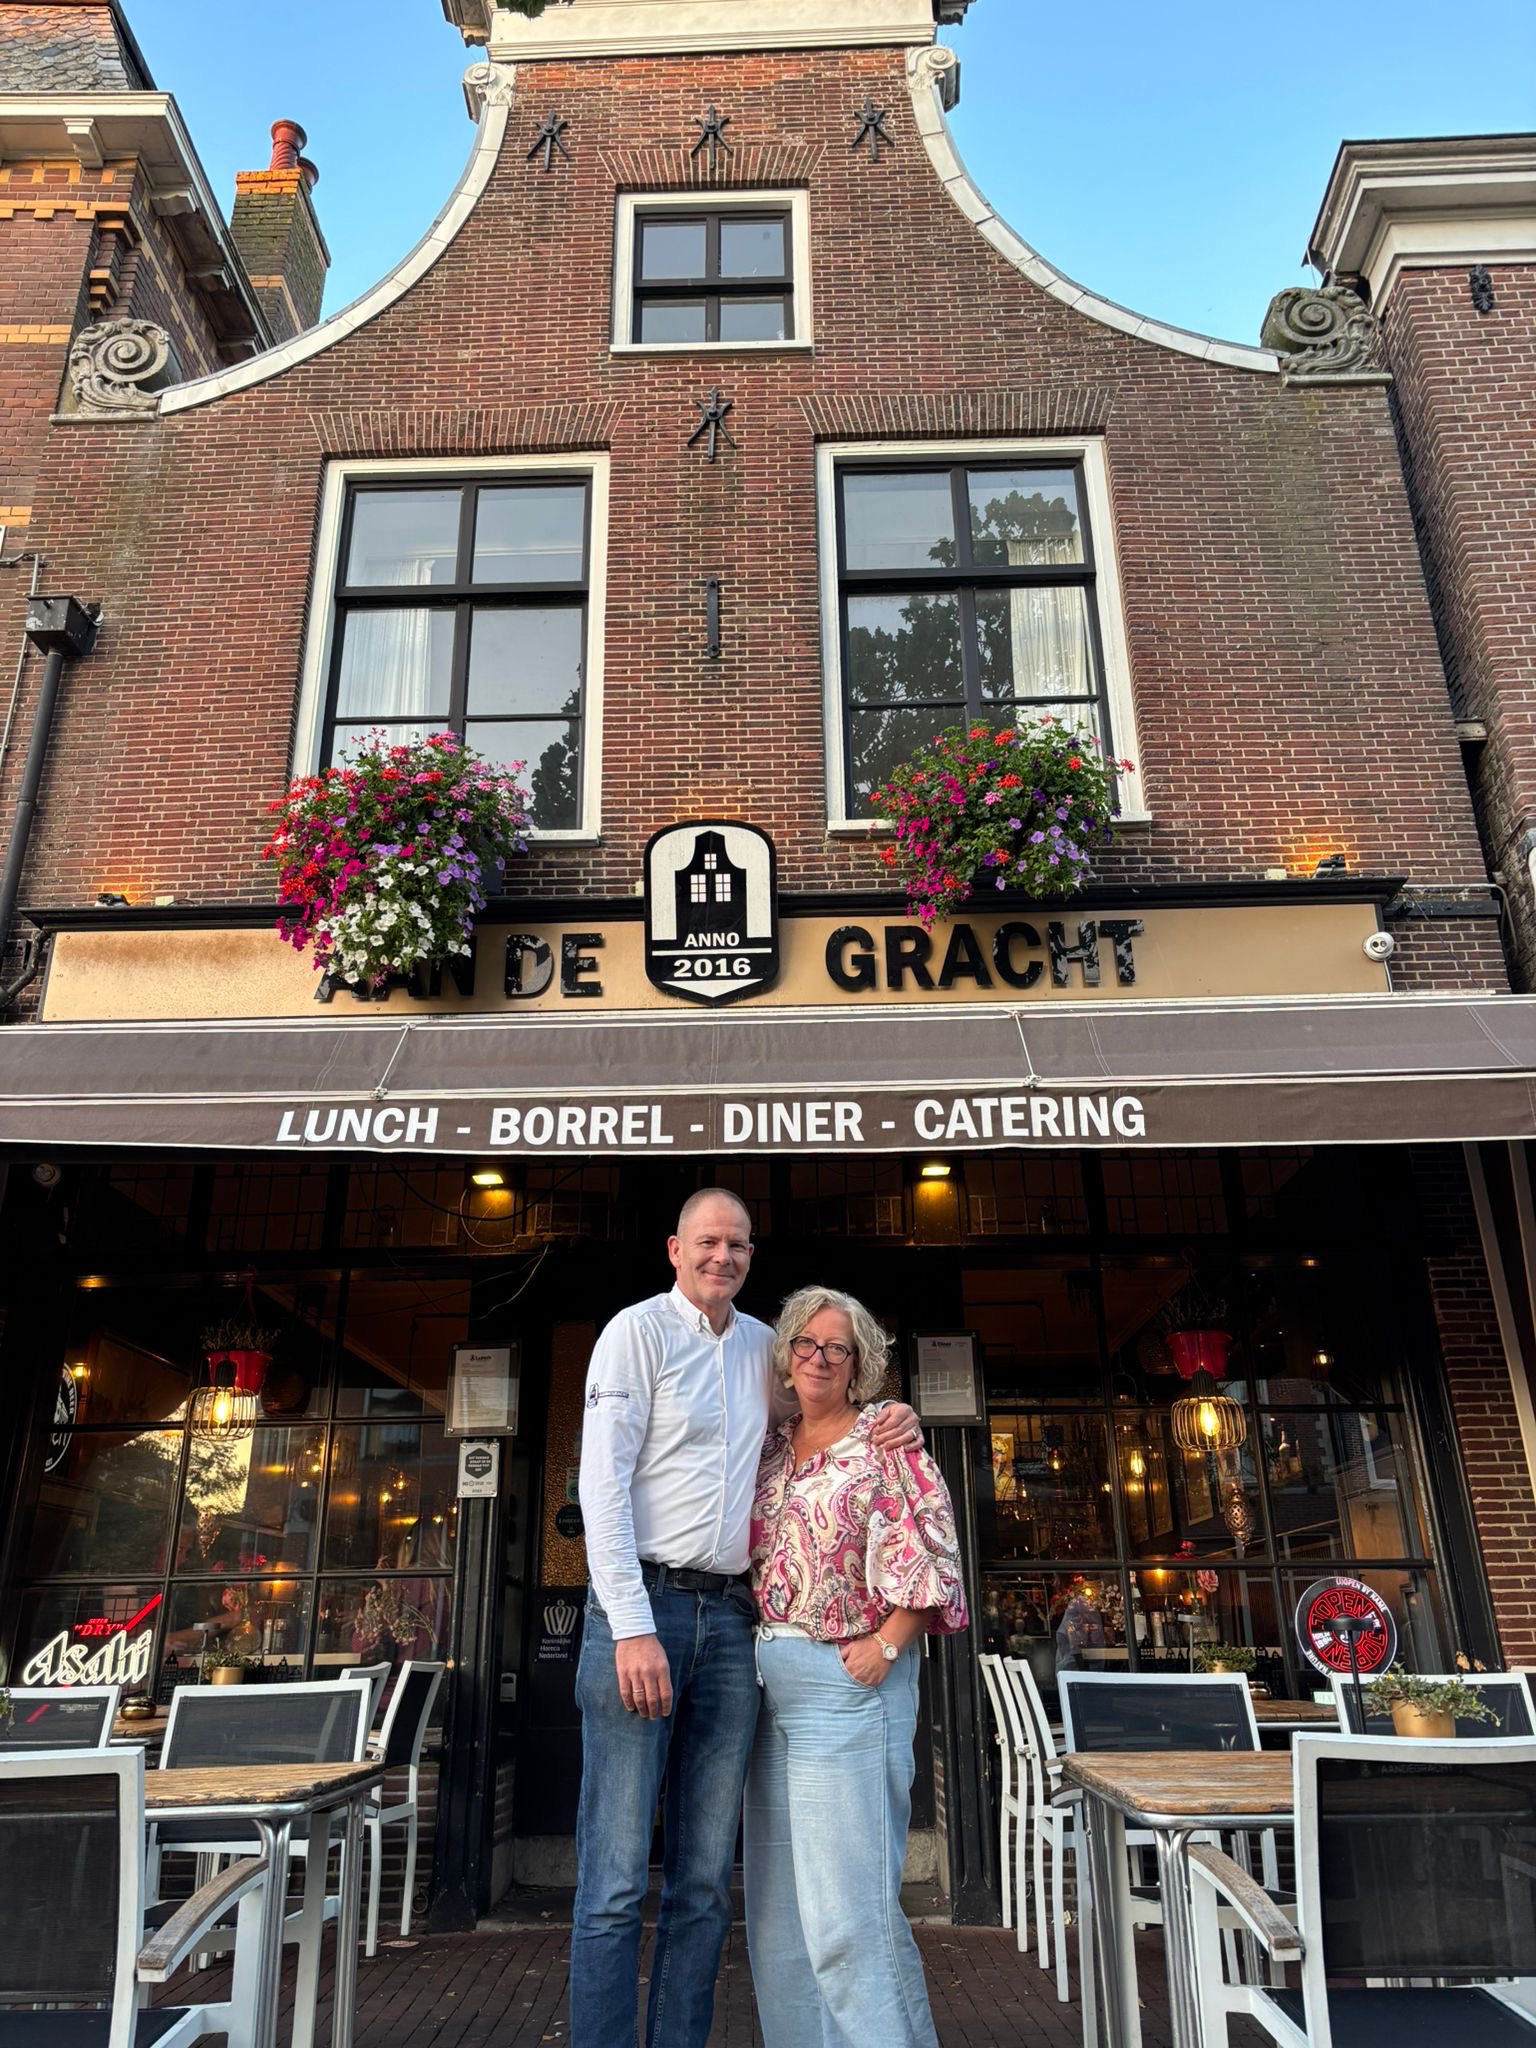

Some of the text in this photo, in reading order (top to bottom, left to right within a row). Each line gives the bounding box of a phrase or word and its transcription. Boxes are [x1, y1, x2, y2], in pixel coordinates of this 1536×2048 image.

[504, 932, 602, 997] DE
[684, 932, 740, 948] ANNO
[824, 918, 1144, 991] GRACHT
[673, 957, 751, 977] 2016
[276, 1107, 439, 1144] LUNCH
[489, 1105, 674, 1145] BORREL
[723, 1101, 865, 1143] DINER
[913, 1096, 1146, 1140] CATERING
[23, 1629, 152, 1686] Asahi
